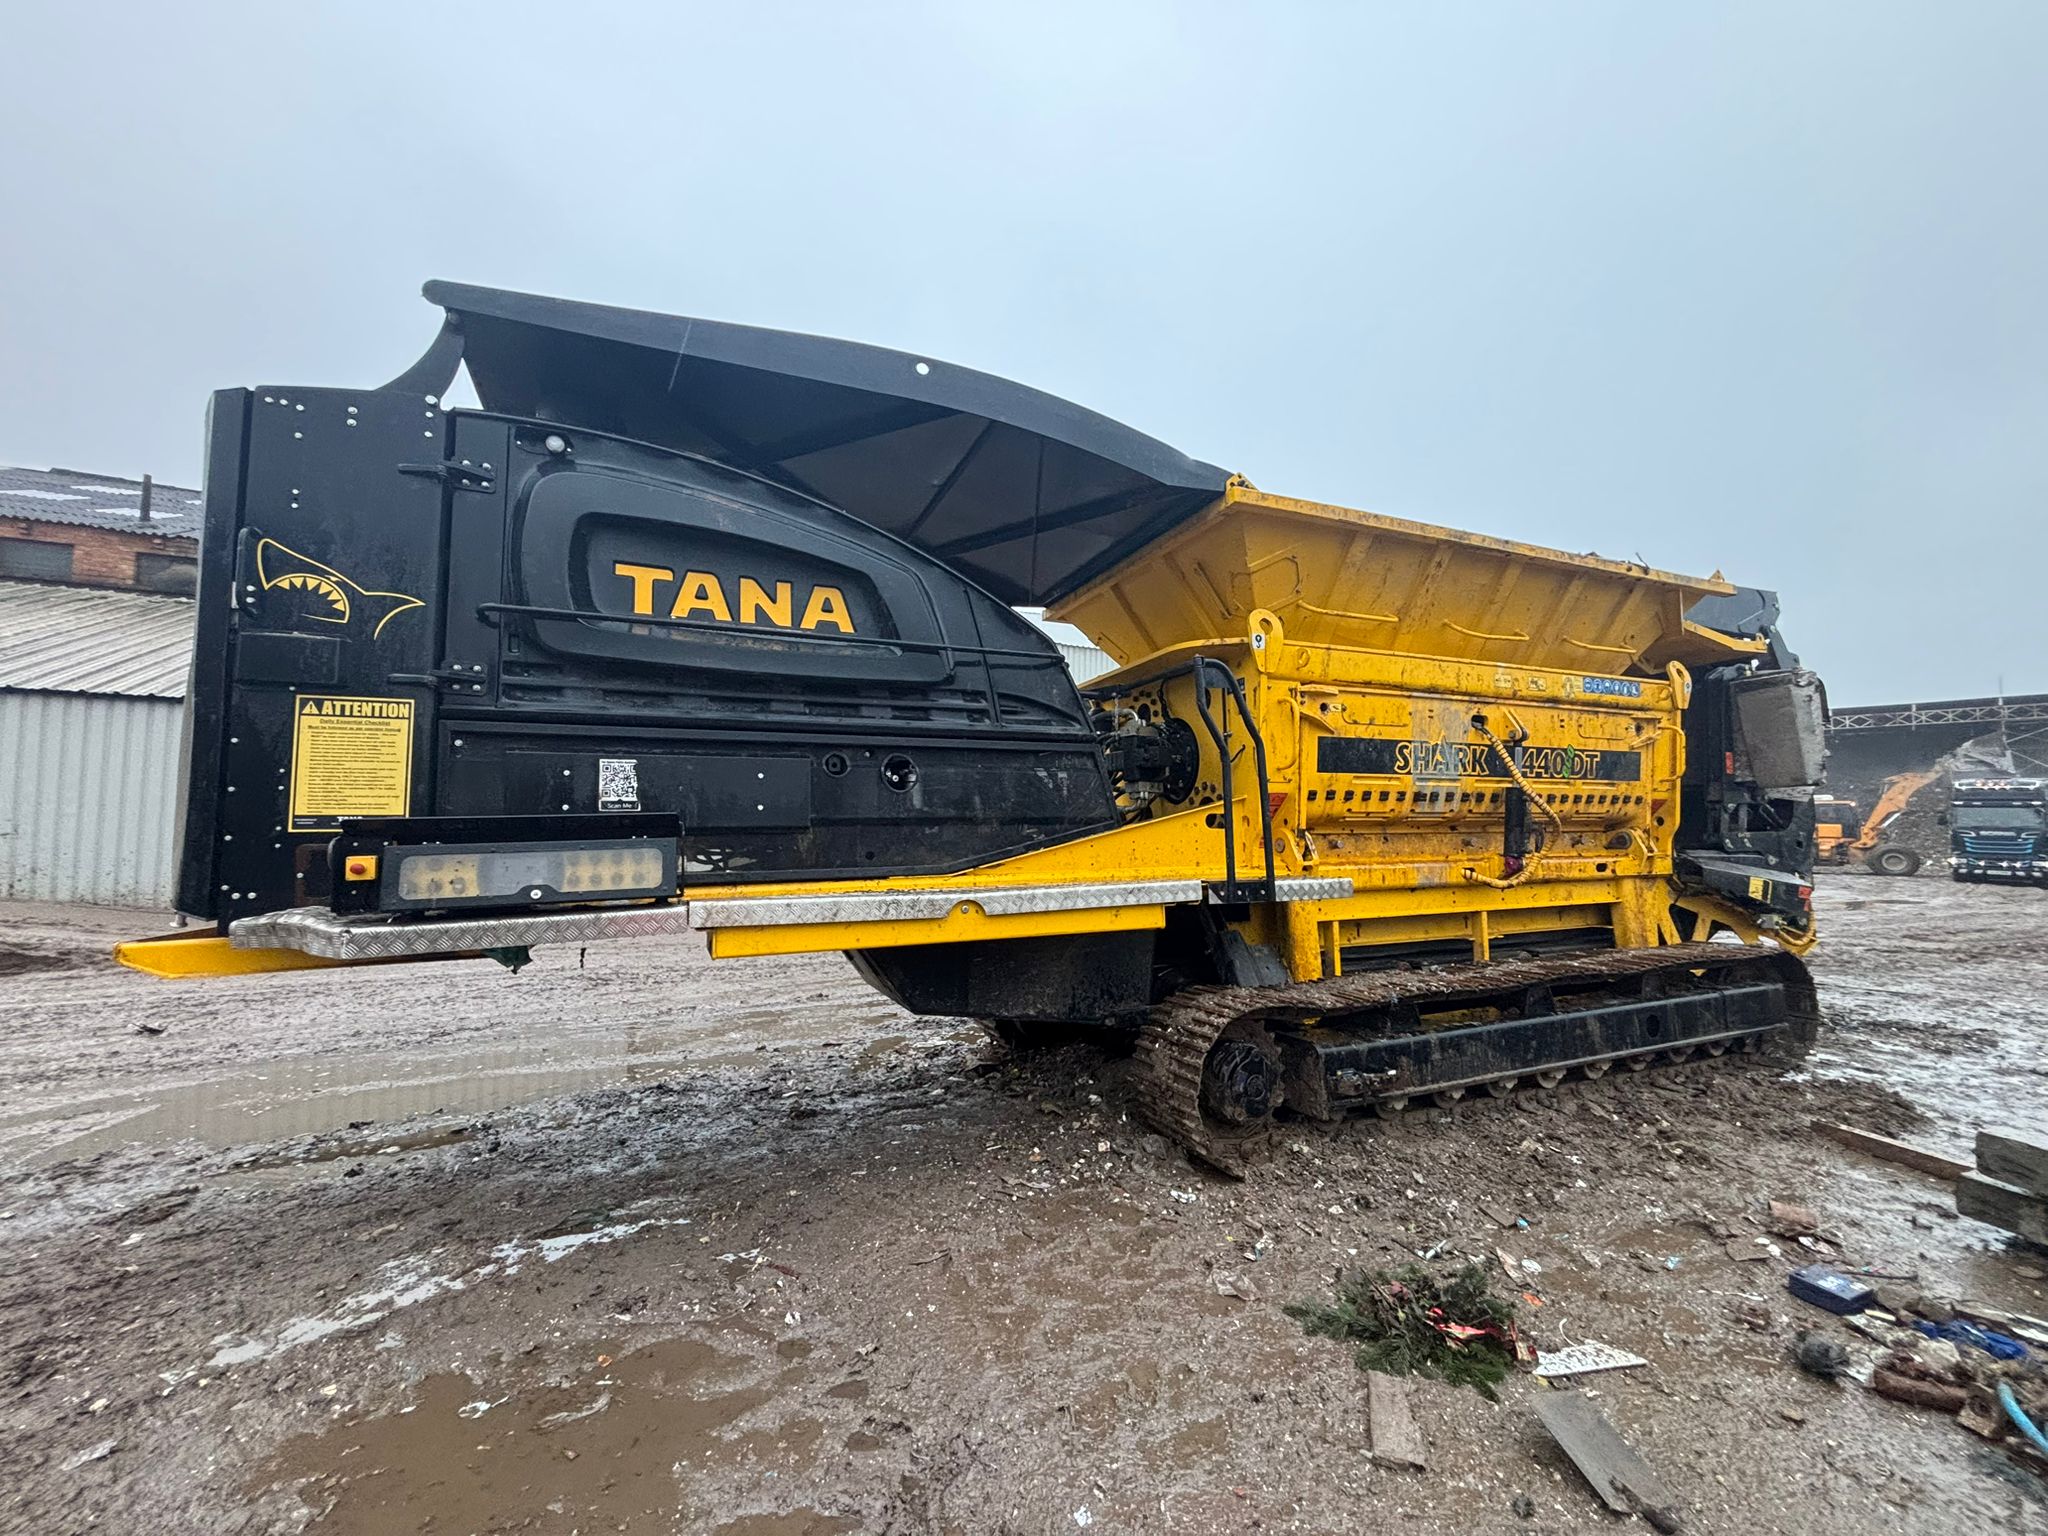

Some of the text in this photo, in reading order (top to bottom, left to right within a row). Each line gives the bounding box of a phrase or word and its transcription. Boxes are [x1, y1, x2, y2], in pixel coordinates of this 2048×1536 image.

[614, 562, 856, 634] TANA
[321, 700, 409, 718] ATTENTION
[1394, 730, 1490, 776] SHARK
